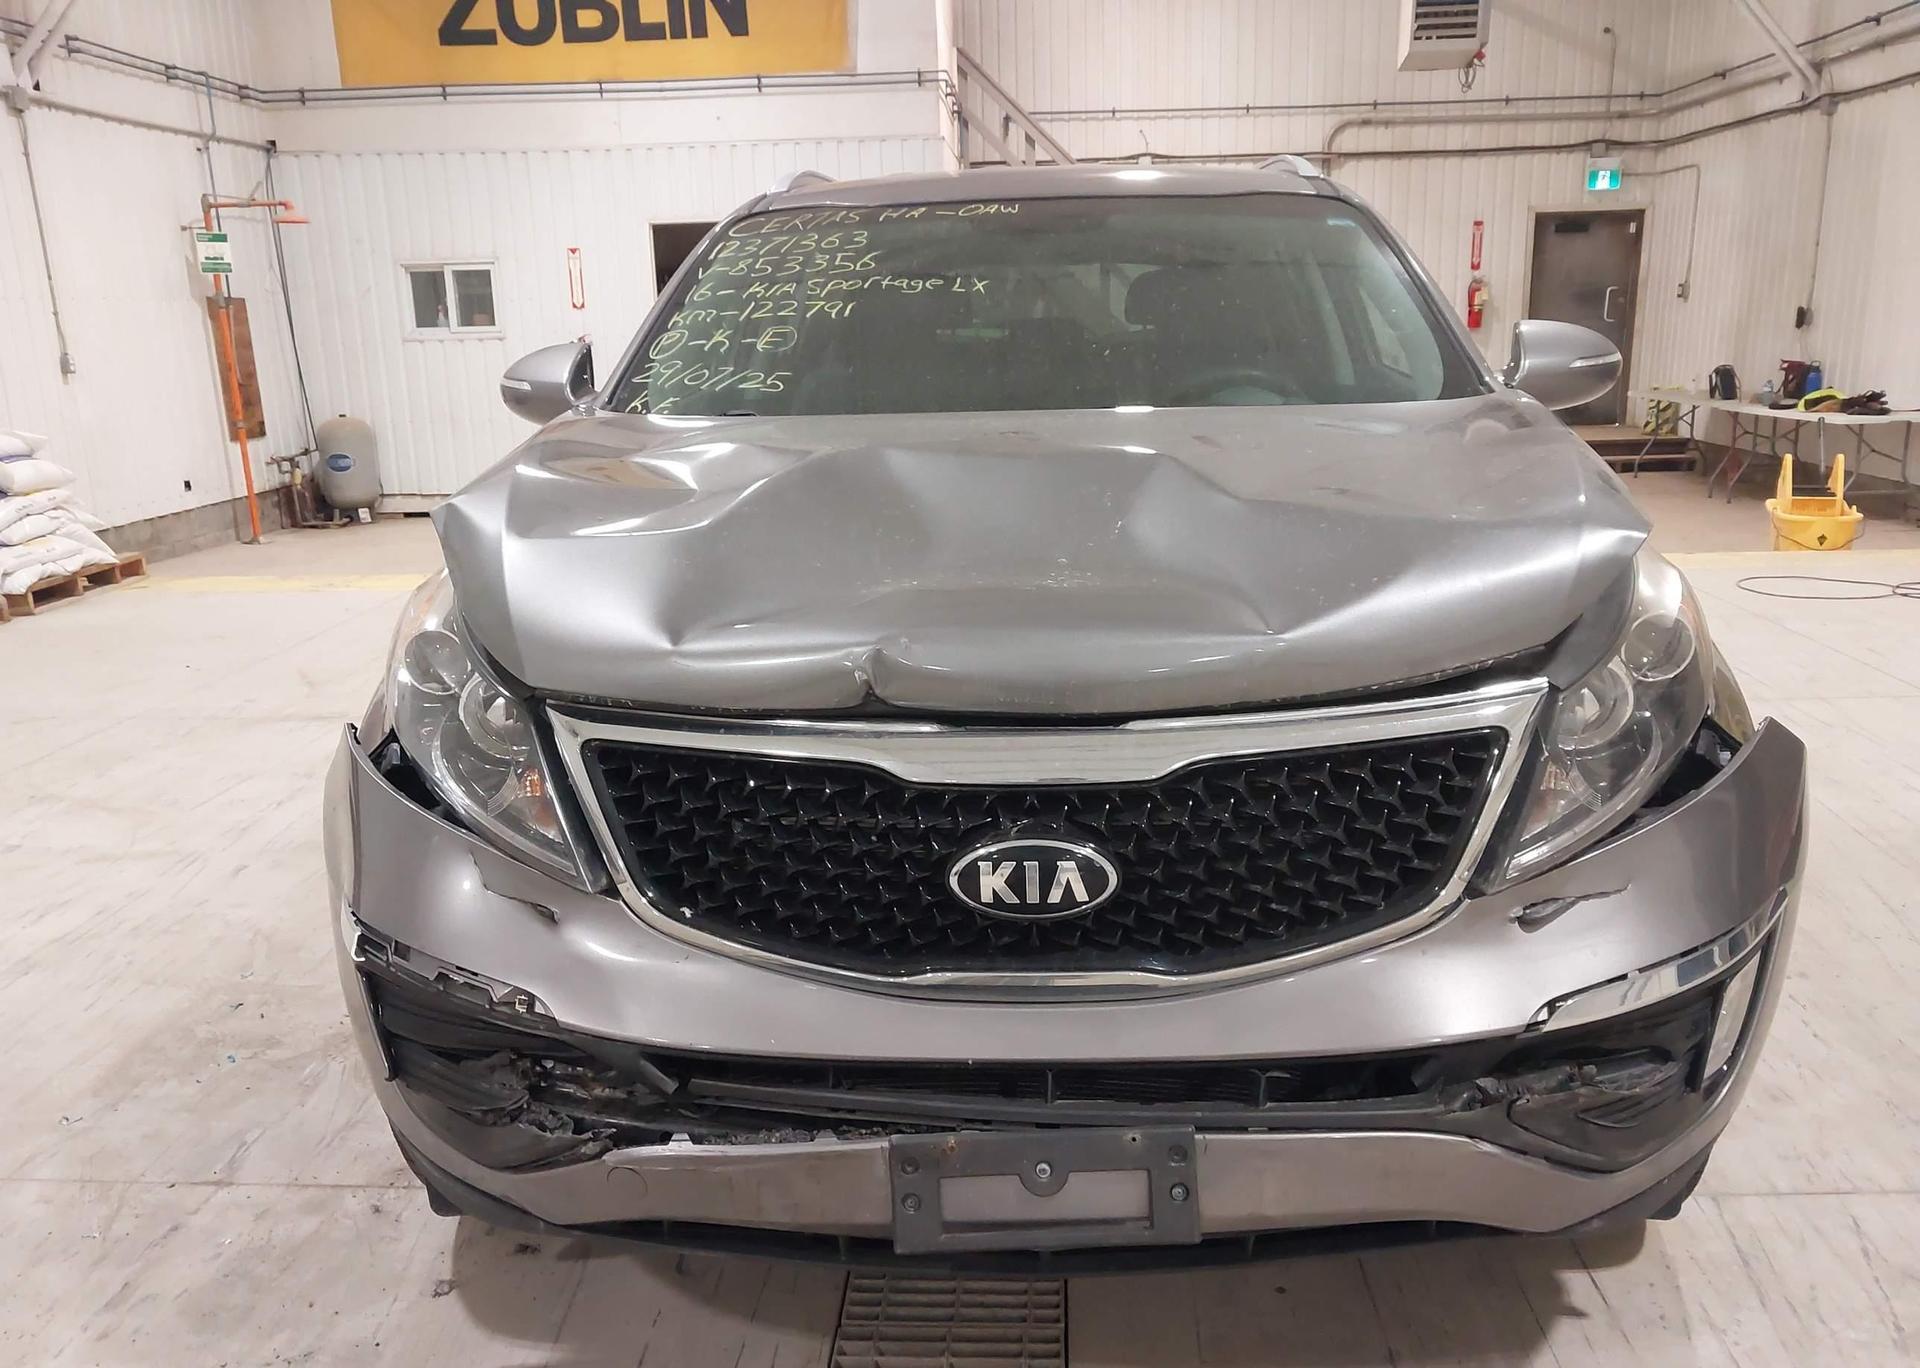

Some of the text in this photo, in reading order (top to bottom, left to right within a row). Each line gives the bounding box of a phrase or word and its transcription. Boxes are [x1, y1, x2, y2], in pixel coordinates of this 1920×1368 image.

[708, 230, 868, 260] 12371363
[952, 277, 989, 295] LX
[632, 360, 793, 392] 29/07/25
[977, 861, 1090, 904] KIA
